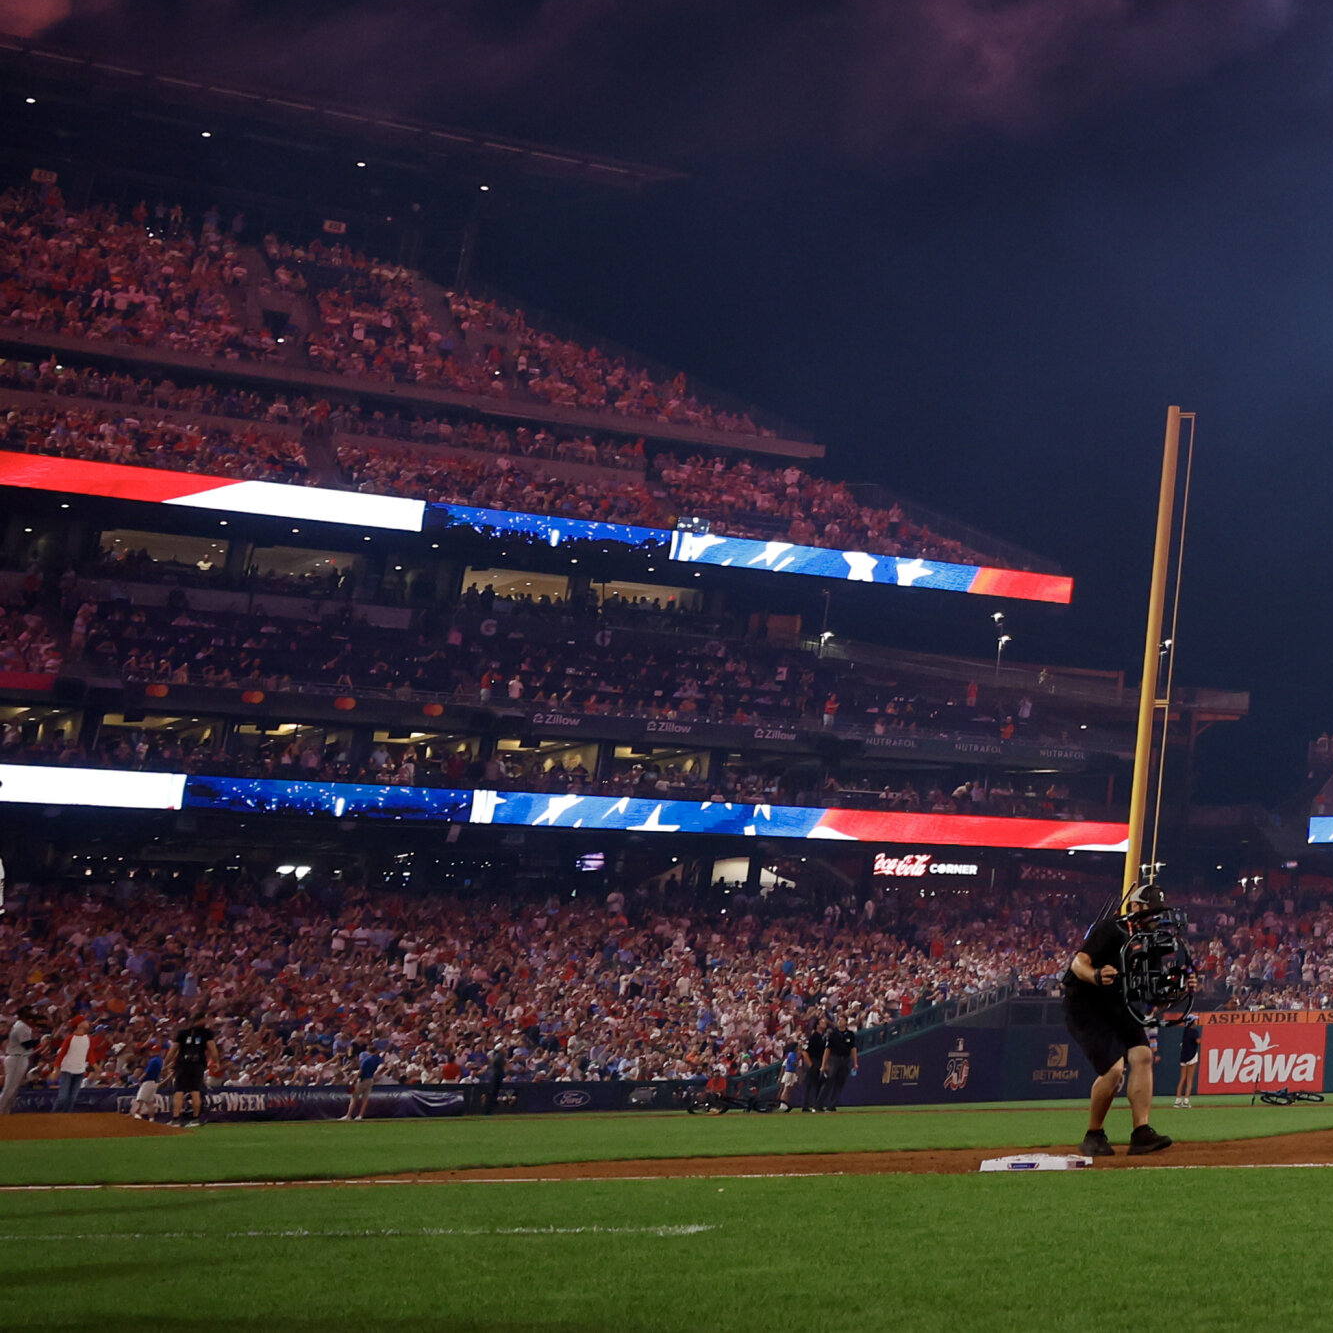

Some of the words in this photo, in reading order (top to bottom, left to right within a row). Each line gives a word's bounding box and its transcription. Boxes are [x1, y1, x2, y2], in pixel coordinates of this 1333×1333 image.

[545, 715, 580, 726] Zillow
[658, 722, 692, 734] Zillow
[765, 729, 797, 740] Zillow
[865, 737, 917, 747] NUTRAFOL
[955, 743, 1002, 753] NUTRAFOL
[1040, 749, 1085, 760] NUTRAFOL
[929, 863, 978, 875] CORNER
[1208, 1012, 1298, 1024] ASPLUNDH
[1209, 1048, 1316, 1084] Wawa
[890, 1064, 920, 1081] BETMGM
[1032, 1069, 1079, 1080] BETMGM
[223, 1092, 266, 1112] WEEK
[559, 1093, 584, 1106] Ford
